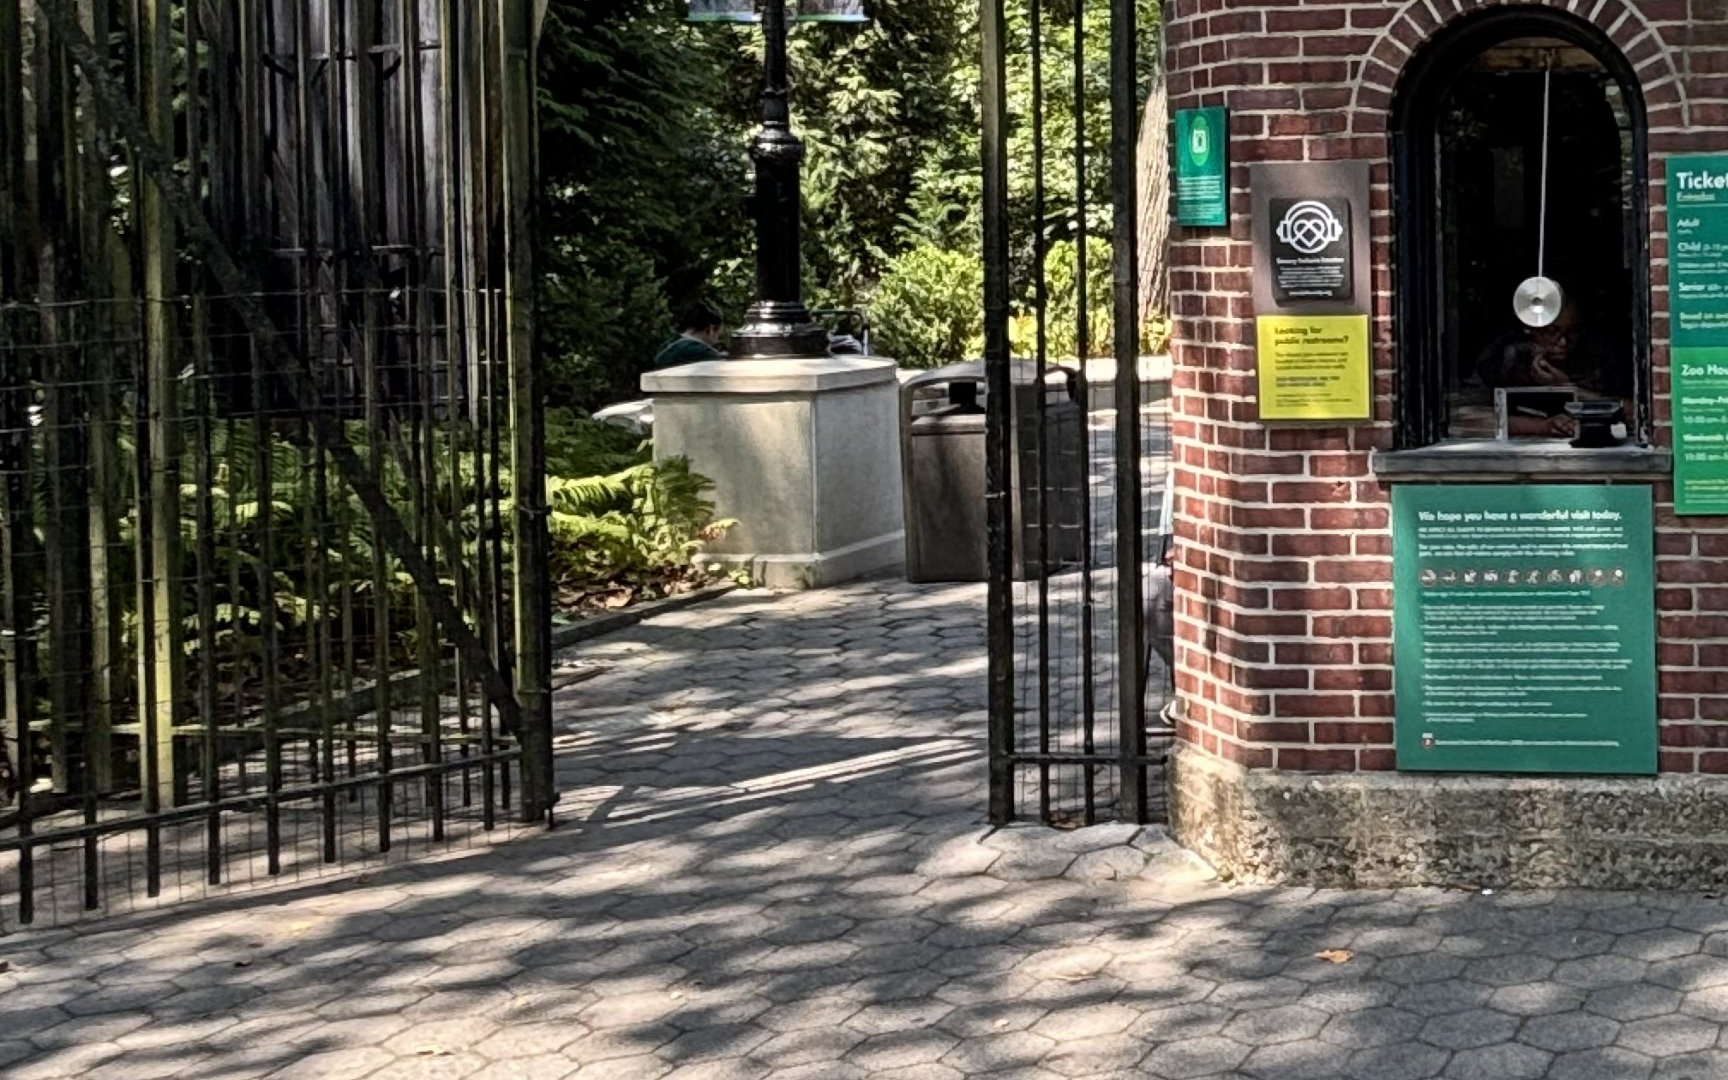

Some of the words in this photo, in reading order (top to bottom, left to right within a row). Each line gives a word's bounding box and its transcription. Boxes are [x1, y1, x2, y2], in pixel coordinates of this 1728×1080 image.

[1676, 217, 1700, 227] Adult
[1677, 241, 1701, 251] Child
[1678, 281, 1705, 291] Senior
[1275, 327, 1307, 336] Looking
[1310, 326, 1322, 334] for
[1275, 336, 1299, 347] public
[1681, 364, 1704, 376] Zoo
[1418, 511, 1435, 521] We
[1437, 510, 1462, 522] hope
[1463, 512, 1483, 523] you
[1483, 510, 1508, 521] have
[1510, 512, 1518, 521] a
[1519, 509, 1568, 521] wonderful
[1570, 509, 1591, 520] visit
[1592, 509, 1623, 521] today.
